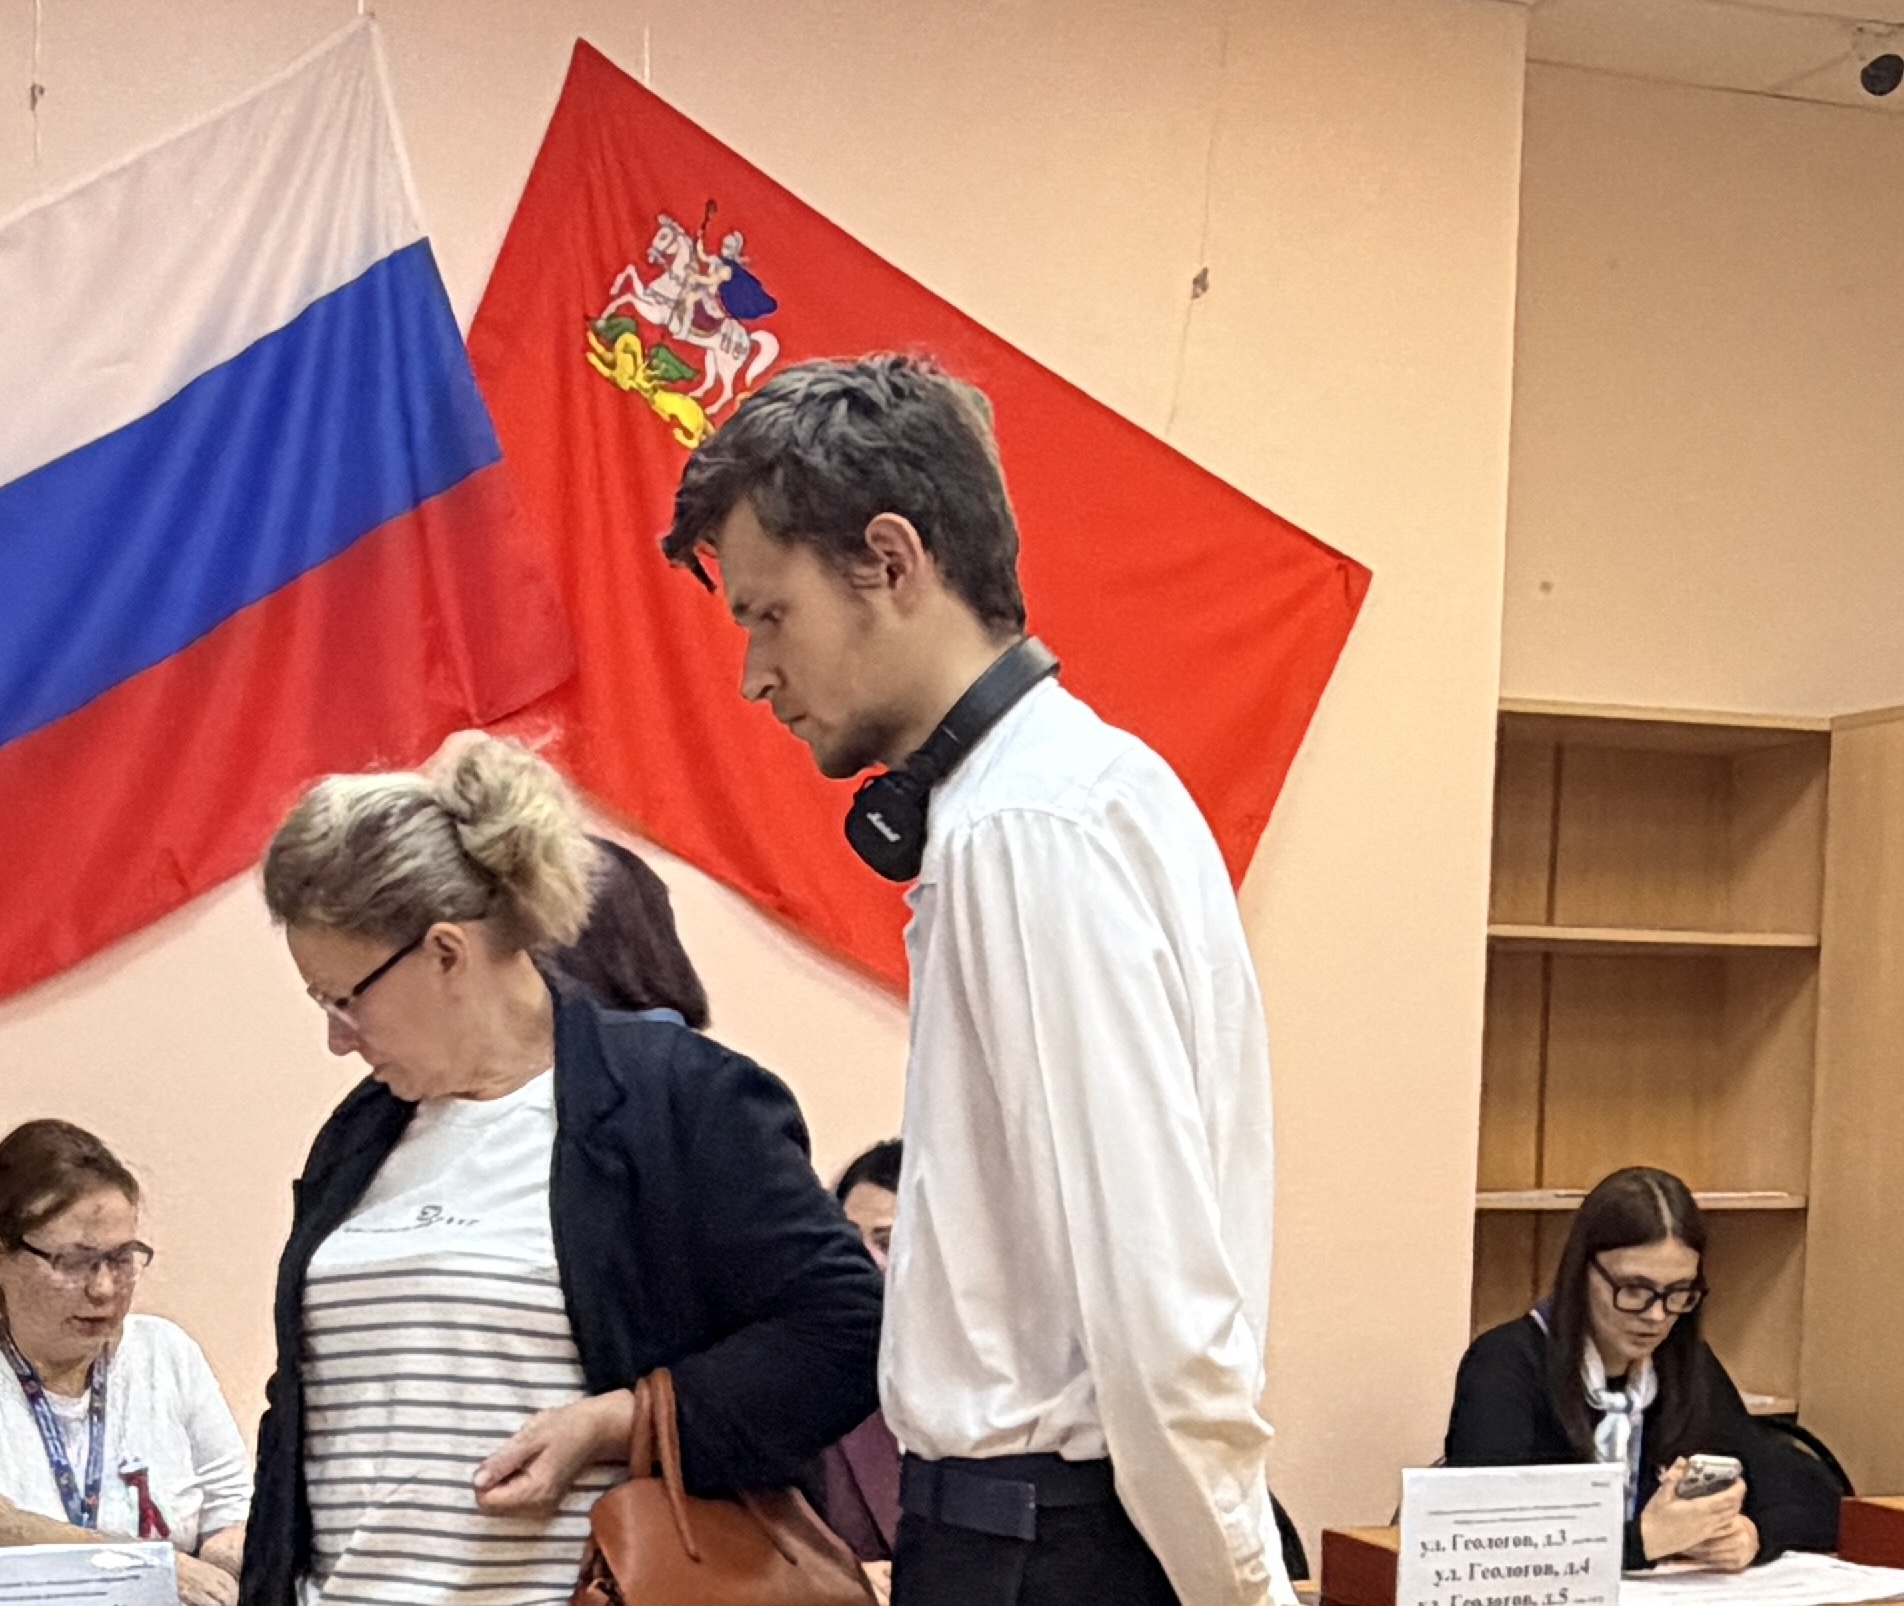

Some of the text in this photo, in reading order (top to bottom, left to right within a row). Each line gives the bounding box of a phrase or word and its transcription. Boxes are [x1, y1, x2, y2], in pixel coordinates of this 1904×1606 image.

[1452, 1533, 1539, 1551] Геологов,
[1468, 1562, 1560, 1582] Геологов,
[1562, 1557, 1590, 1577] д.4
